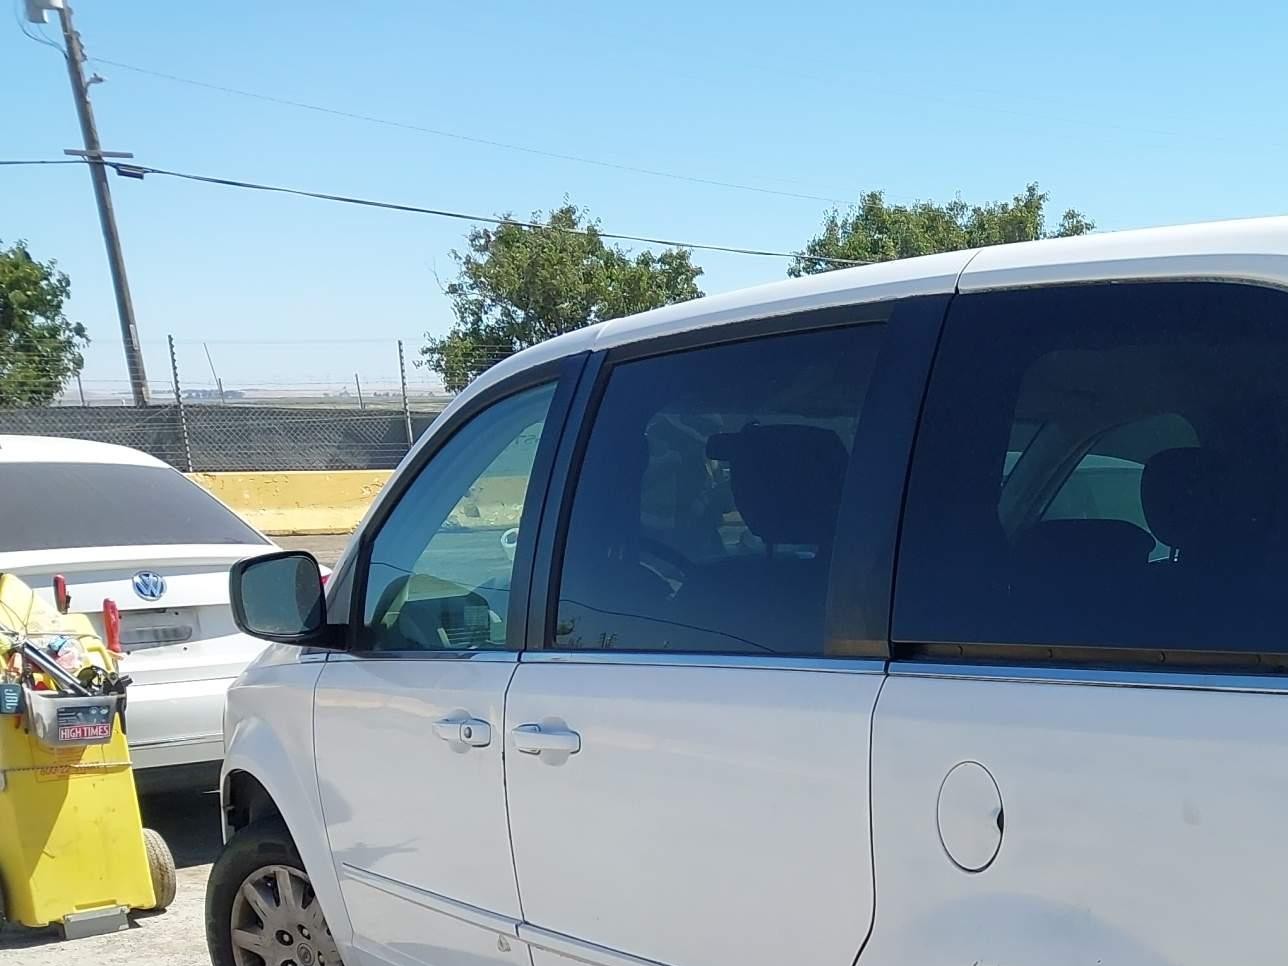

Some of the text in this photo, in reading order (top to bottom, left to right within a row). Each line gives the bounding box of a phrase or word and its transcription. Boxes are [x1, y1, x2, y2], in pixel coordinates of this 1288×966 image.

[4, 688, 18, 709] JBL
[61, 726, 109, 739] HIGH TIMES
